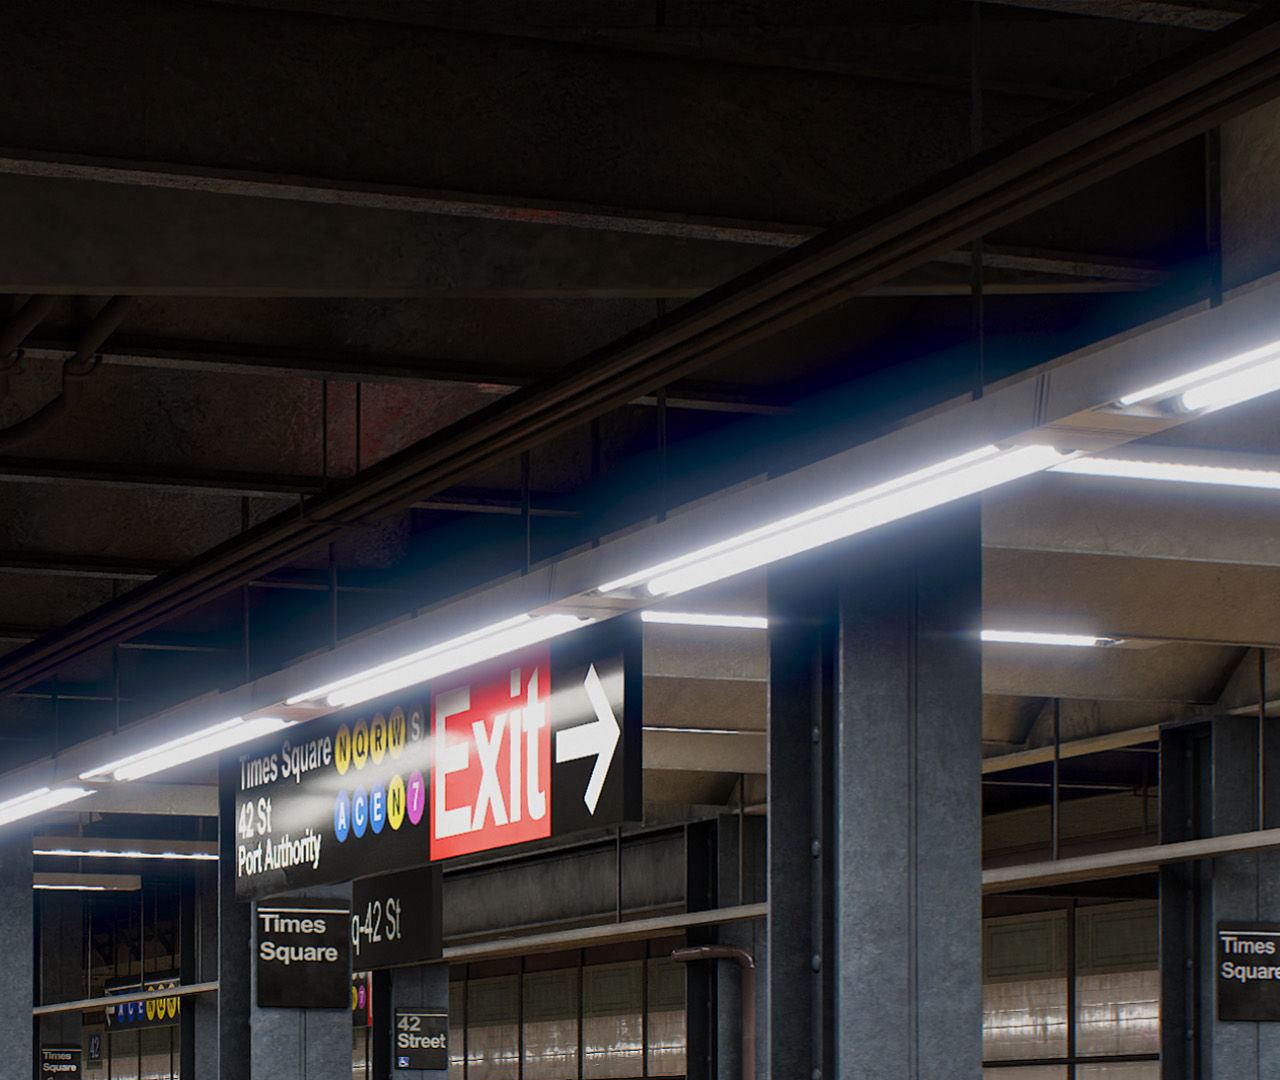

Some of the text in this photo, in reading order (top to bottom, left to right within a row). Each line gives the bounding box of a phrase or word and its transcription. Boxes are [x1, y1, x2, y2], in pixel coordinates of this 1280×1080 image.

[239, 753, 278, 791] Times
[281, 735, 332, 784] Square
[434, 666, 547, 840] Exit
[238, 797, 273, 839] 42 St
[237, 828, 322, 878] Port Authority
[258, 914, 327, 934] Times
[385, 898, 402, 941] St
[259, 941, 339, 966] Square
[1220, 936, 1277, 955] Times
[397, 1016, 422, 1032] 42
[397, 1033, 447, 1049] Street
[42, 1052, 73, 1060] Times
[42, 1062, 78, 1073] Square
